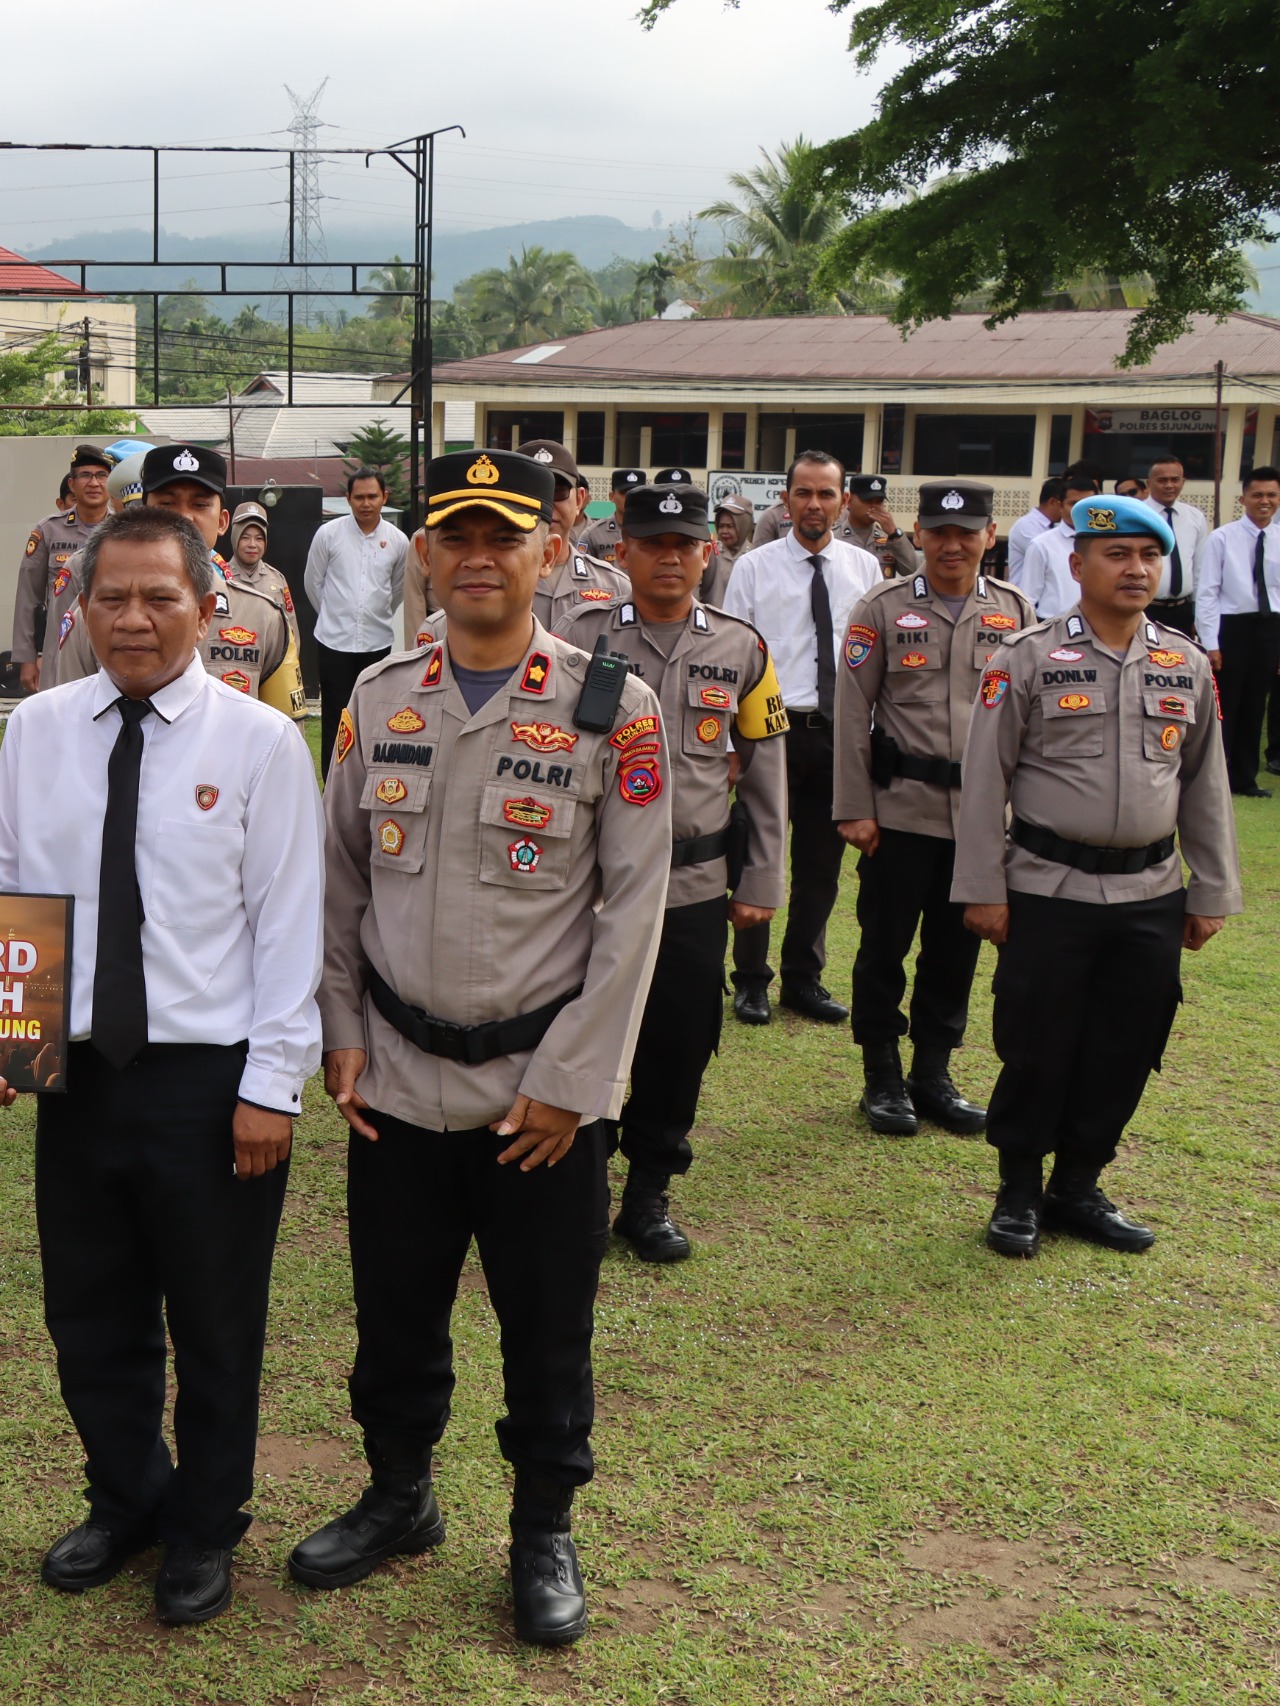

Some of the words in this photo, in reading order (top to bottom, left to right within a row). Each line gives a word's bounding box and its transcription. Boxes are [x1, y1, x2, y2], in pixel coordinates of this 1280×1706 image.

[1140, 410, 1202, 421] BAGLOG
[1120, 422, 1158, 431] POLRES
[51, 542, 78, 550] AZMAN
[897, 631, 929, 645] RIKI
[210, 646, 260, 662] POLRI
[688, 664, 739, 685] POLRI
[1144, 673, 1194, 690] POLRI
[615, 718, 654, 744] POLRES
[496, 756, 573, 788] POLRI
